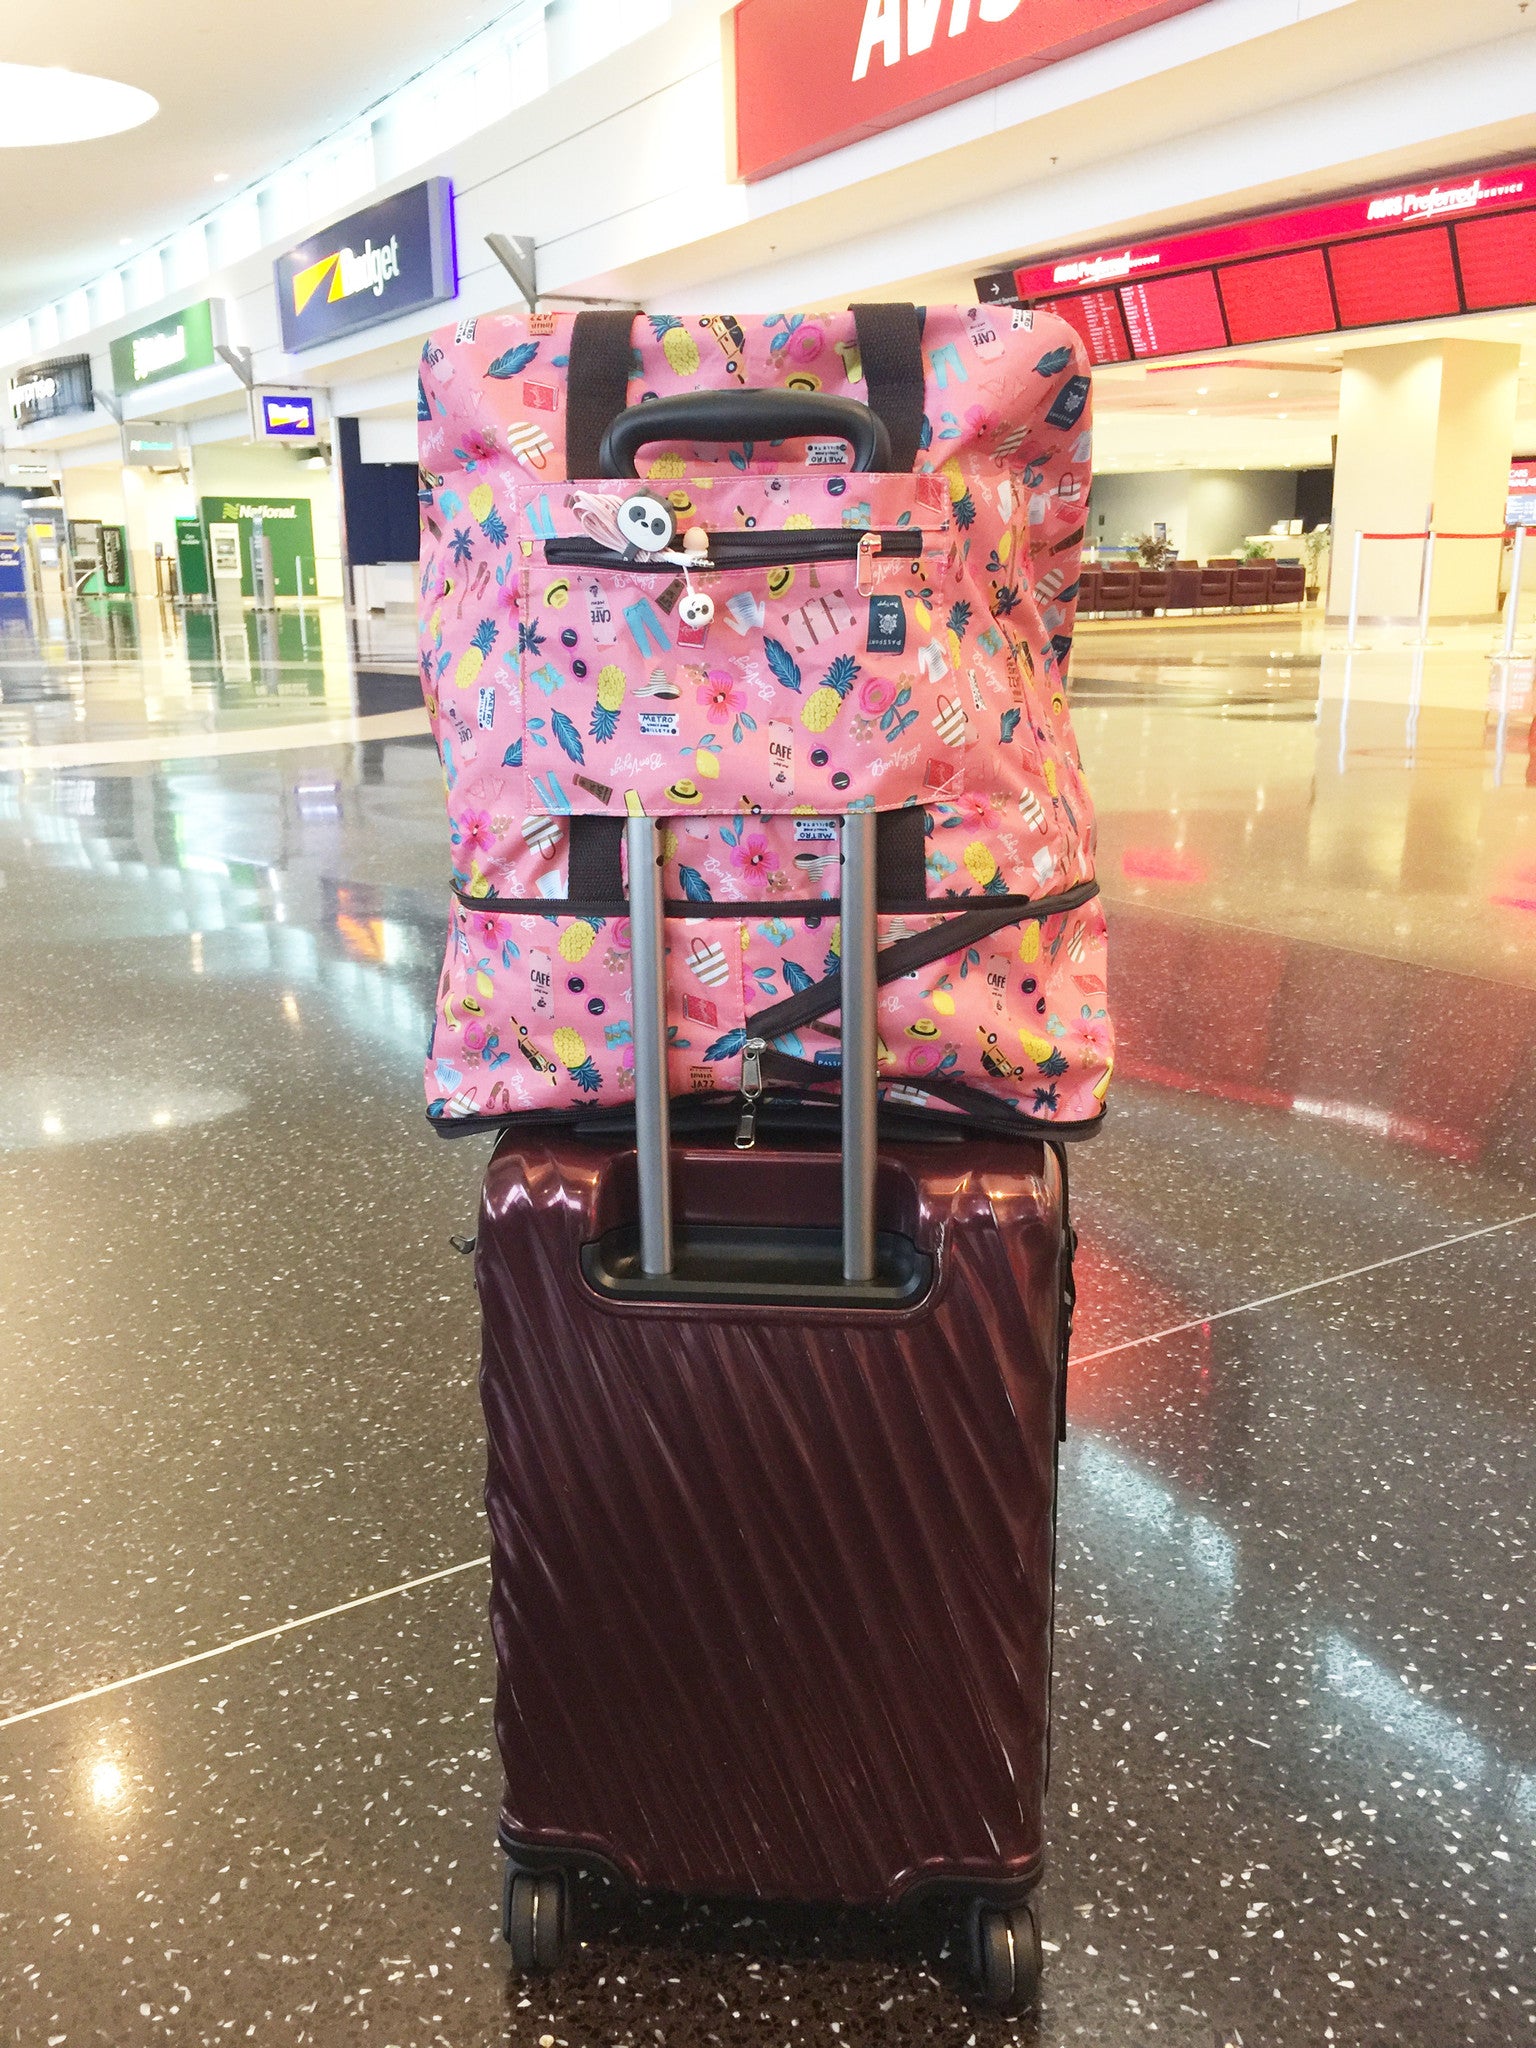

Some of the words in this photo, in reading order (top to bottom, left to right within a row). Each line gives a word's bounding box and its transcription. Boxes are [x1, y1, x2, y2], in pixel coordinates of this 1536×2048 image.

[852, 0, 1022, 82] AVI
[1403, 179, 1480, 218] Preferred
[339, 234, 400, 297] Budget
[591, 609, 611, 625] CAFÉ
[486, 691, 494, 725] METRO
[643, 715, 673, 723] METRO
[769, 742, 793, 760] CAFÉ
[640, 752, 667, 771] Bon
[865, 757, 894, 777] Bon
[703, 854, 725, 878] Bon
[530, 969, 551, 987] CAFÉ
[987, 972, 1007, 989] CAFÉ
